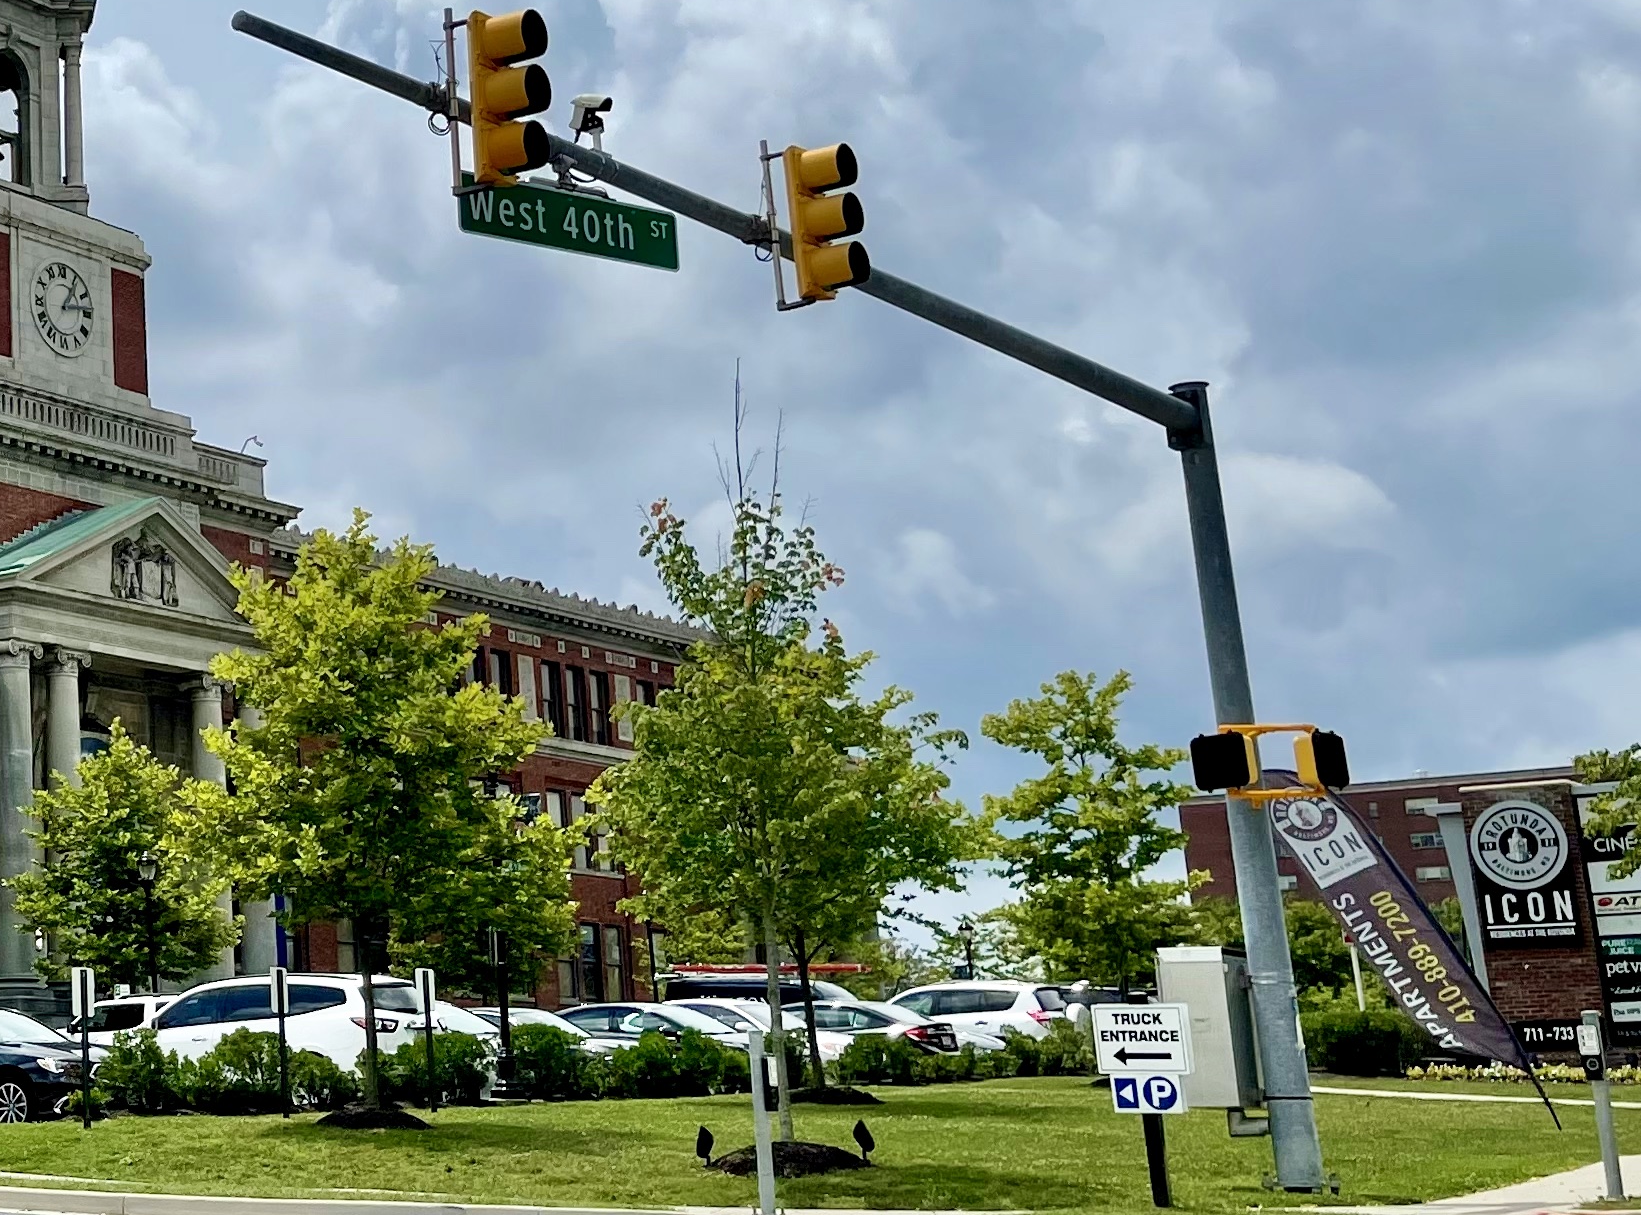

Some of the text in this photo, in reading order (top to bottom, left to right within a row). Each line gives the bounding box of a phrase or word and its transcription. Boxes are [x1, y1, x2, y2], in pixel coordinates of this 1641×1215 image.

[469, 190, 669, 251] West 40th ST
[1486, 813, 1547, 839] ROTUNDA
[1303, 832, 1363, 872] ICON
[1484, 890, 1574, 924] ICON
[1333, 892, 1463, 1049] APARTMENTS
[1369, 891, 1476, 1023] 410-889-7200
[1112, 1013, 1163, 1025] TRUCK
[1523, 1026, 1575, 1041] 711-733
[1100, 1030, 1180, 1042] ENTRANCE
[1150, 1079, 1172, 1108] P
